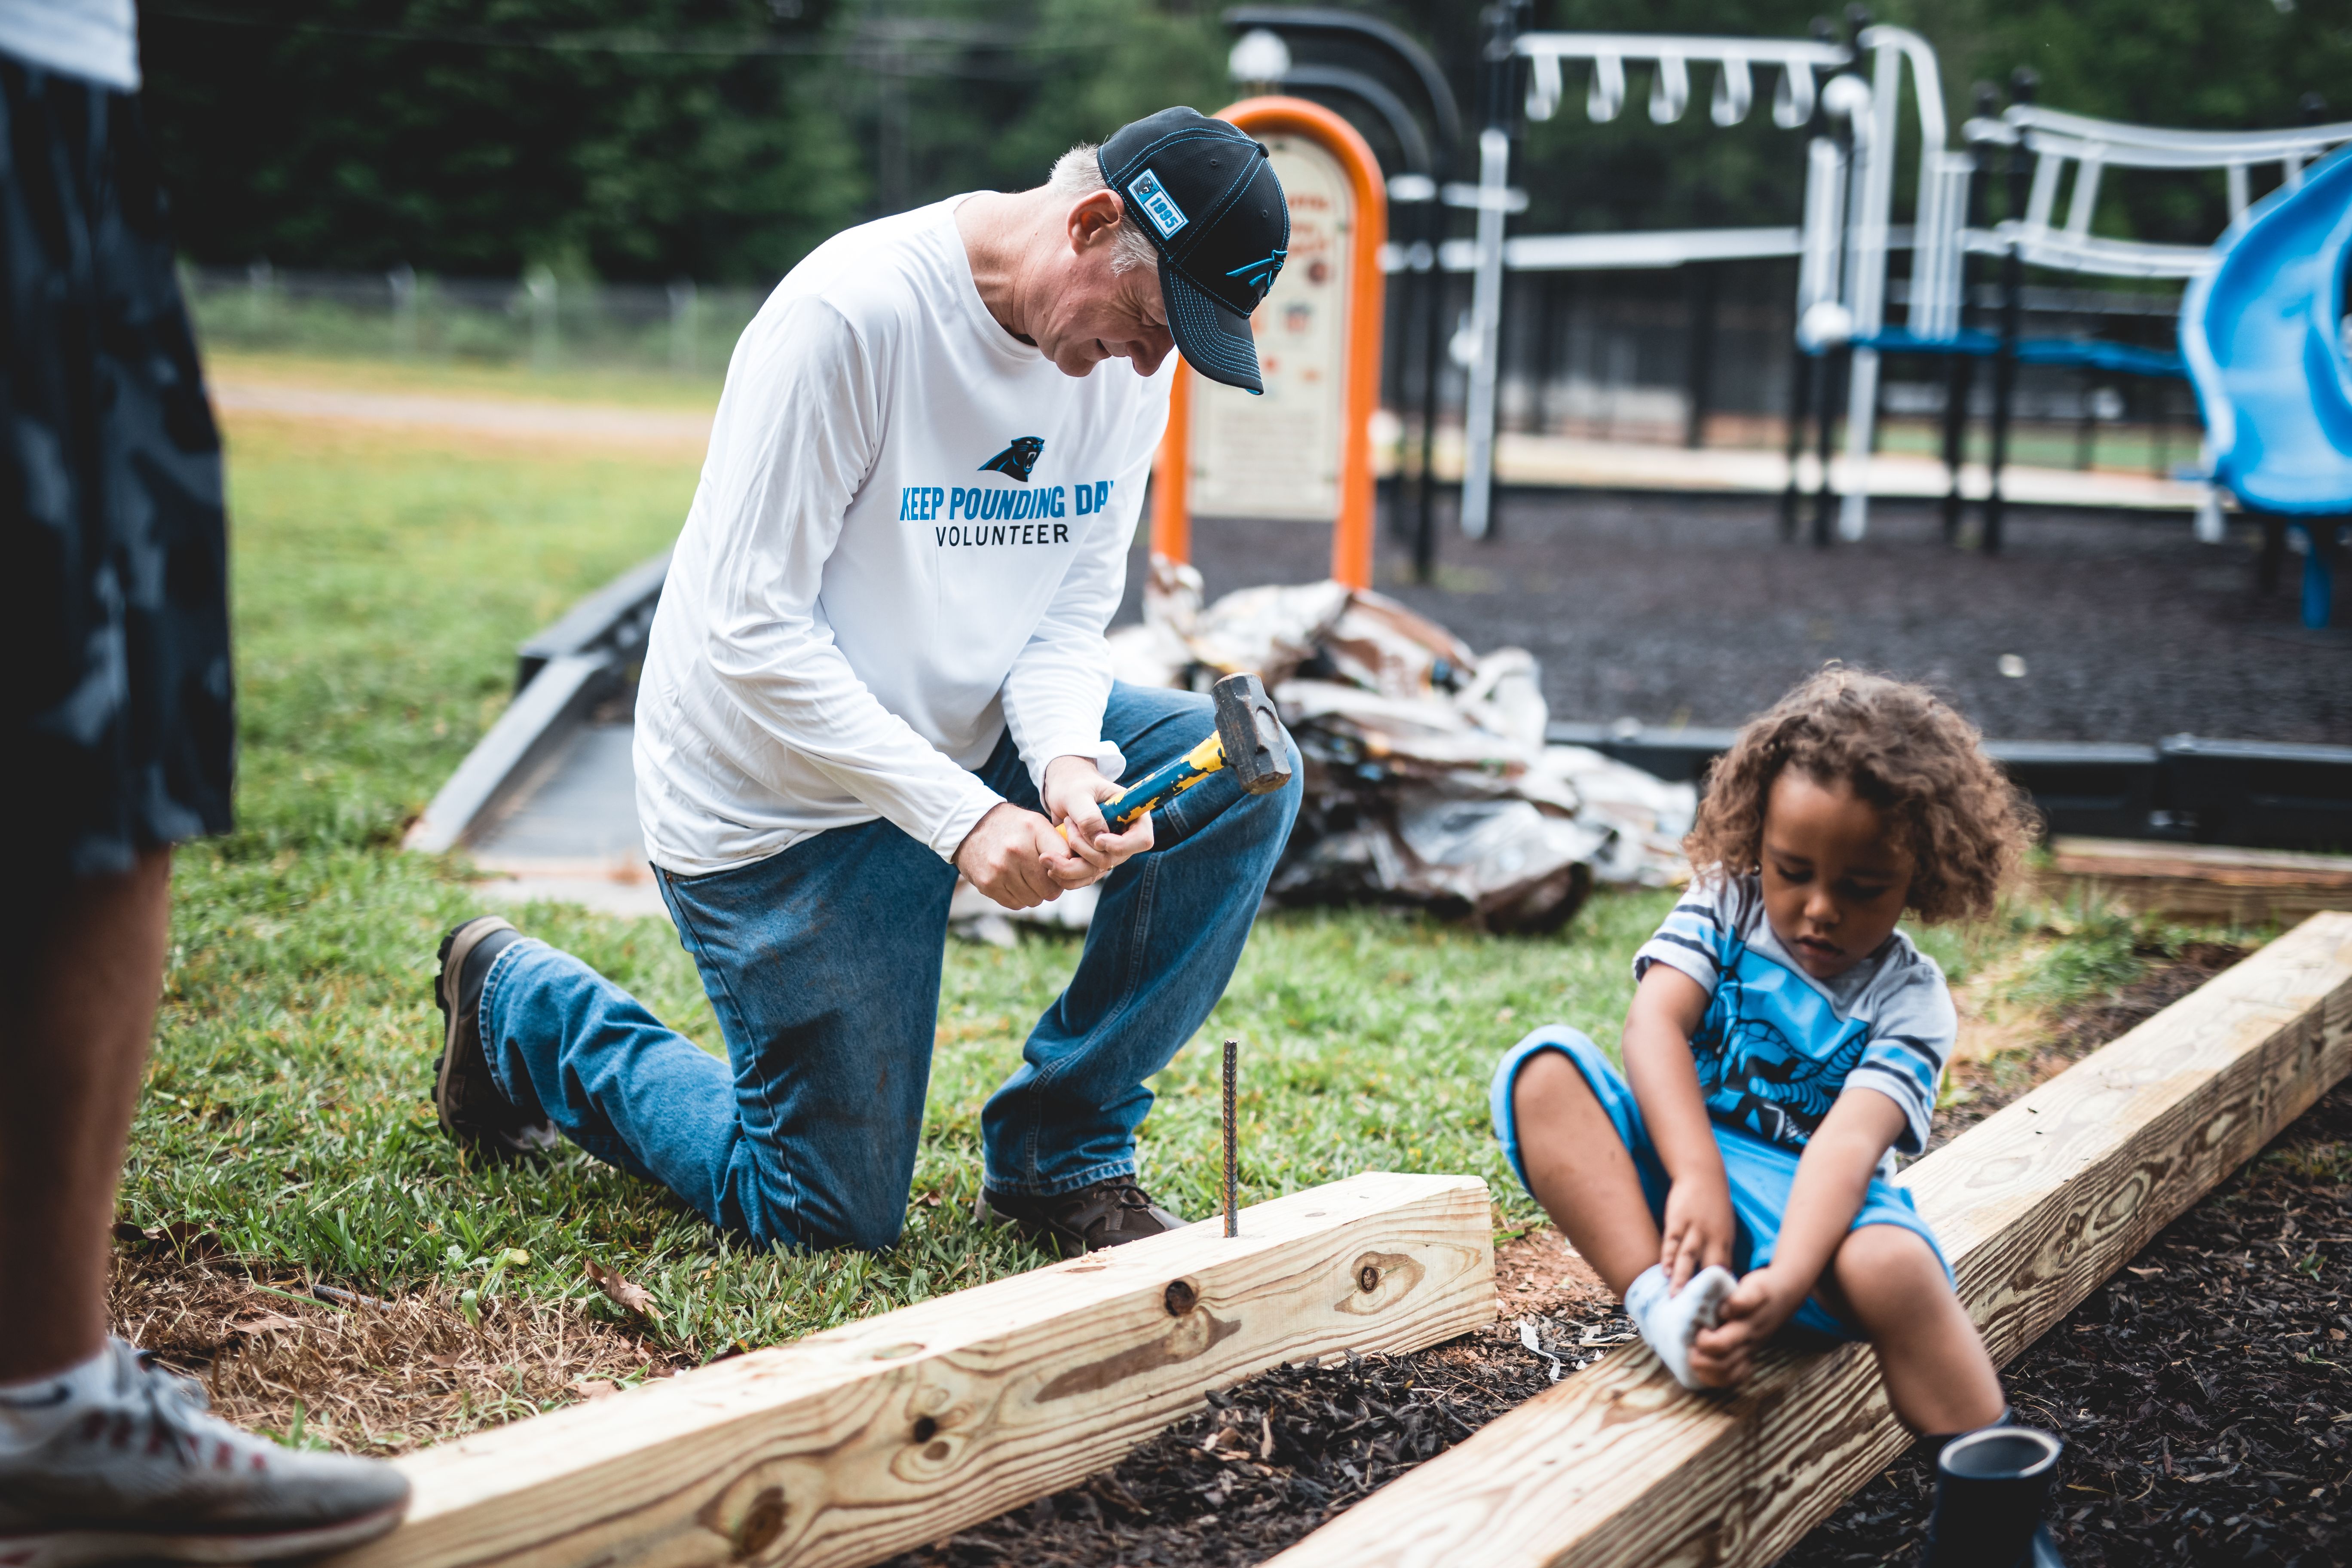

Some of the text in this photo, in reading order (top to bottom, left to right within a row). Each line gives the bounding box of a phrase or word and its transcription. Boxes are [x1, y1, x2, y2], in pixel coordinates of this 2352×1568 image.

[1150, 197, 1179, 228] 1995
[900, 481, 1114, 521] KEEP POUNDING DA
[936, 524, 1069, 547] VOLUNTEER
